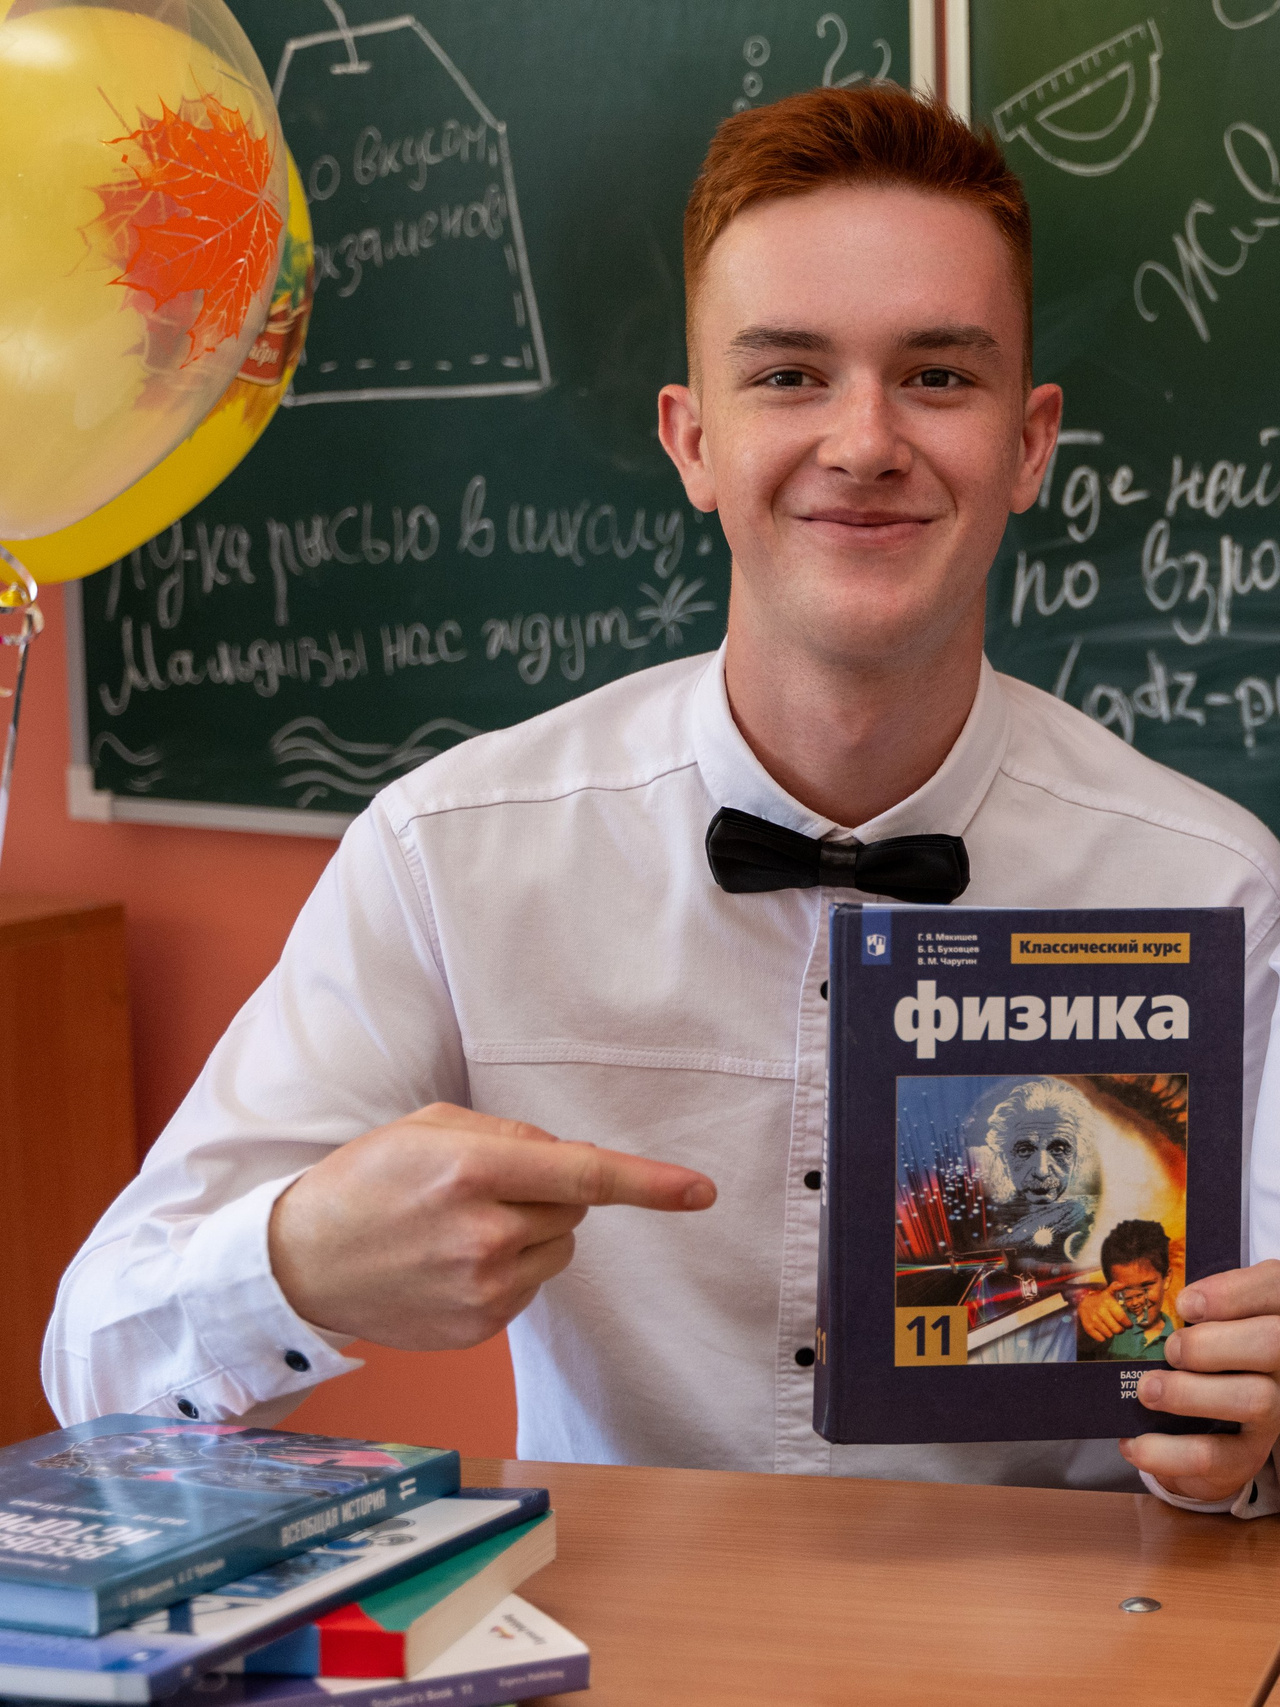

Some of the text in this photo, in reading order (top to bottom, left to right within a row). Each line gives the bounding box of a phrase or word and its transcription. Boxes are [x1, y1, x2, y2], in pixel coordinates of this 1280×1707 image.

[1011, 550, 1100, 628] по
[380, 618, 468, 675] нас
[936, 933, 978, 942] Мякишев
[1019, 939, 1182, 957] Классический курс
[937, 945, 980, 955] Буховцев
[940, 957, 977, 967] Чаругин
[894, 980, 1190, 1059] физика
[816, 1327, 827, 1365] 11
[906, 1315, 952, 1356] 11
[1120, 1370, 1147, 1379] БАЗО
[1120, 1381, 1138, 1389] УГЛ
[399, 1477, 417, 1500] 11
[280, 1489, 387, 1547] ВСЕОБЩАЯ ИСТОРИЯ
